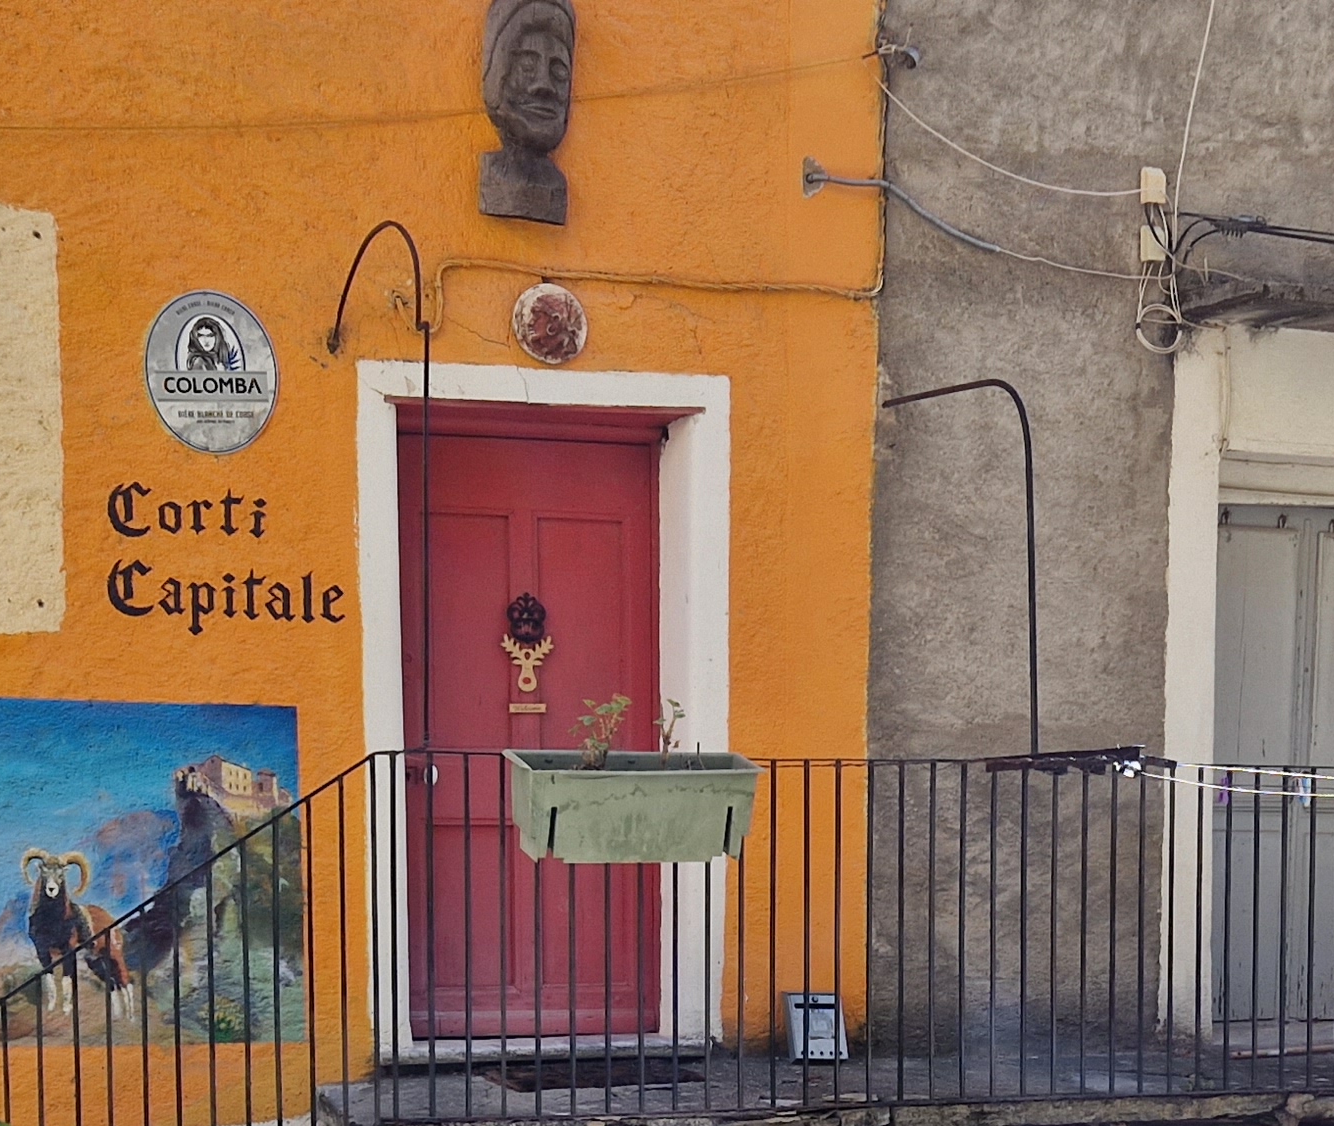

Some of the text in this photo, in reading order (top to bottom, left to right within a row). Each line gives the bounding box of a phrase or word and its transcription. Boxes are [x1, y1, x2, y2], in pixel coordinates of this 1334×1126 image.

[164, 377, 262, 394] COLOMBA
[107, 481, 267, 539] Corti
[107, 559, 345, 636] Capitale
